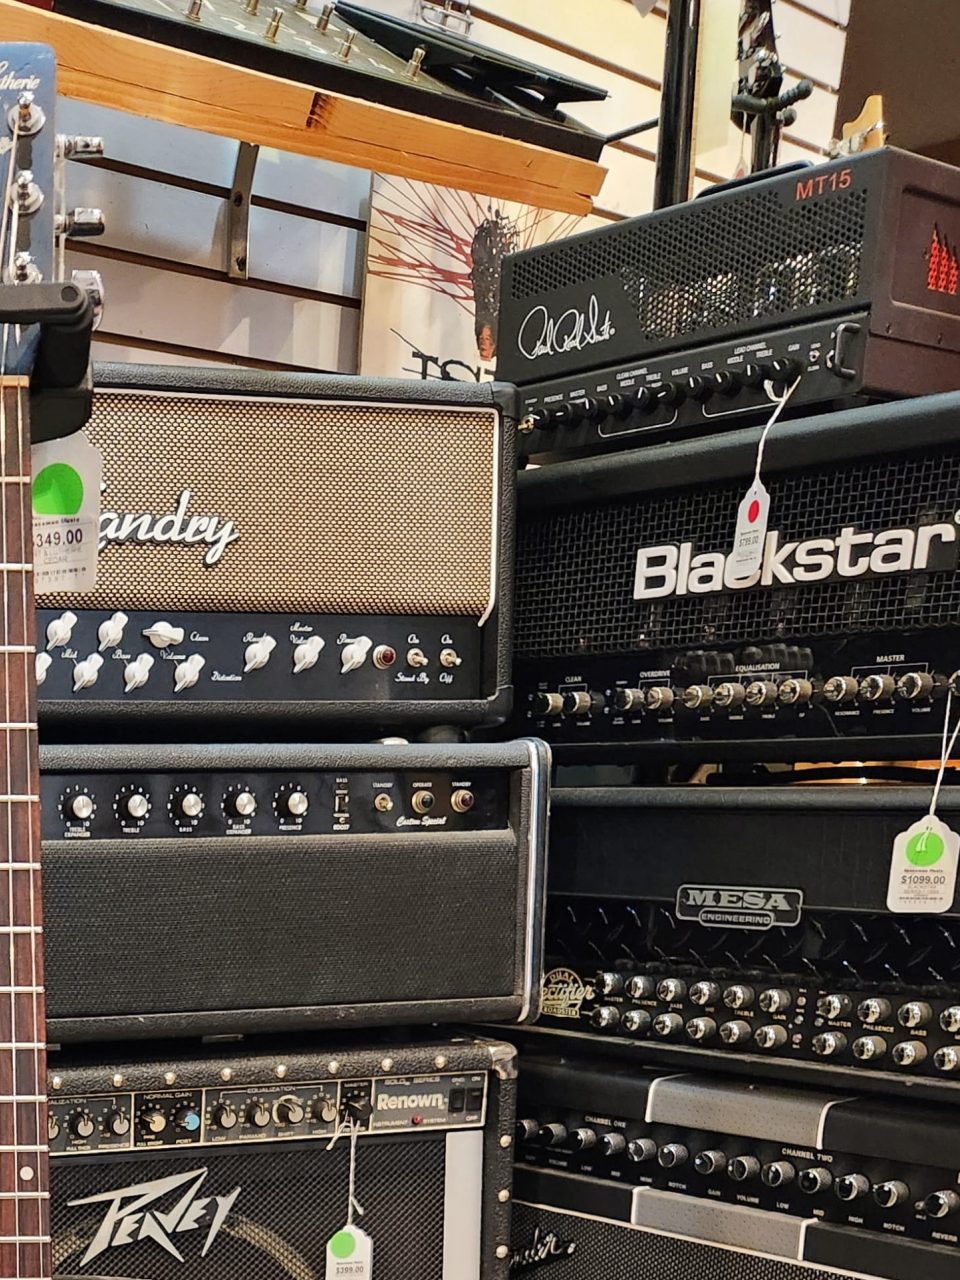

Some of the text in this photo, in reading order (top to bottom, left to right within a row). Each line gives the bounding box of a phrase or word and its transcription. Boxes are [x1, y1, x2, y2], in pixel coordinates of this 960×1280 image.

[795, 168, 853, 201] MT15
[98, 486, 240, 565] andry
[35, 528, 83, 548] 349.00
[876, 655, 905, 663] MASTER
[735, 663, 780, 672] EQUALISATION
[439, 672, 453, 683] Off
[901, 875, 946, 884] $1099.00
[686, 889, 792, 911] MESA
[701, 912, 771, 924] ENGINEERING
[542, 982, 596, 1007] ectifier
[247, 1086, 296, 1094] EQUALIZATION
[377, 1093, 444, 1111] Renown
[782, 1147, 833, 1163] CHANNEL TWO
[776, 1201, 790, 1210] LOW
